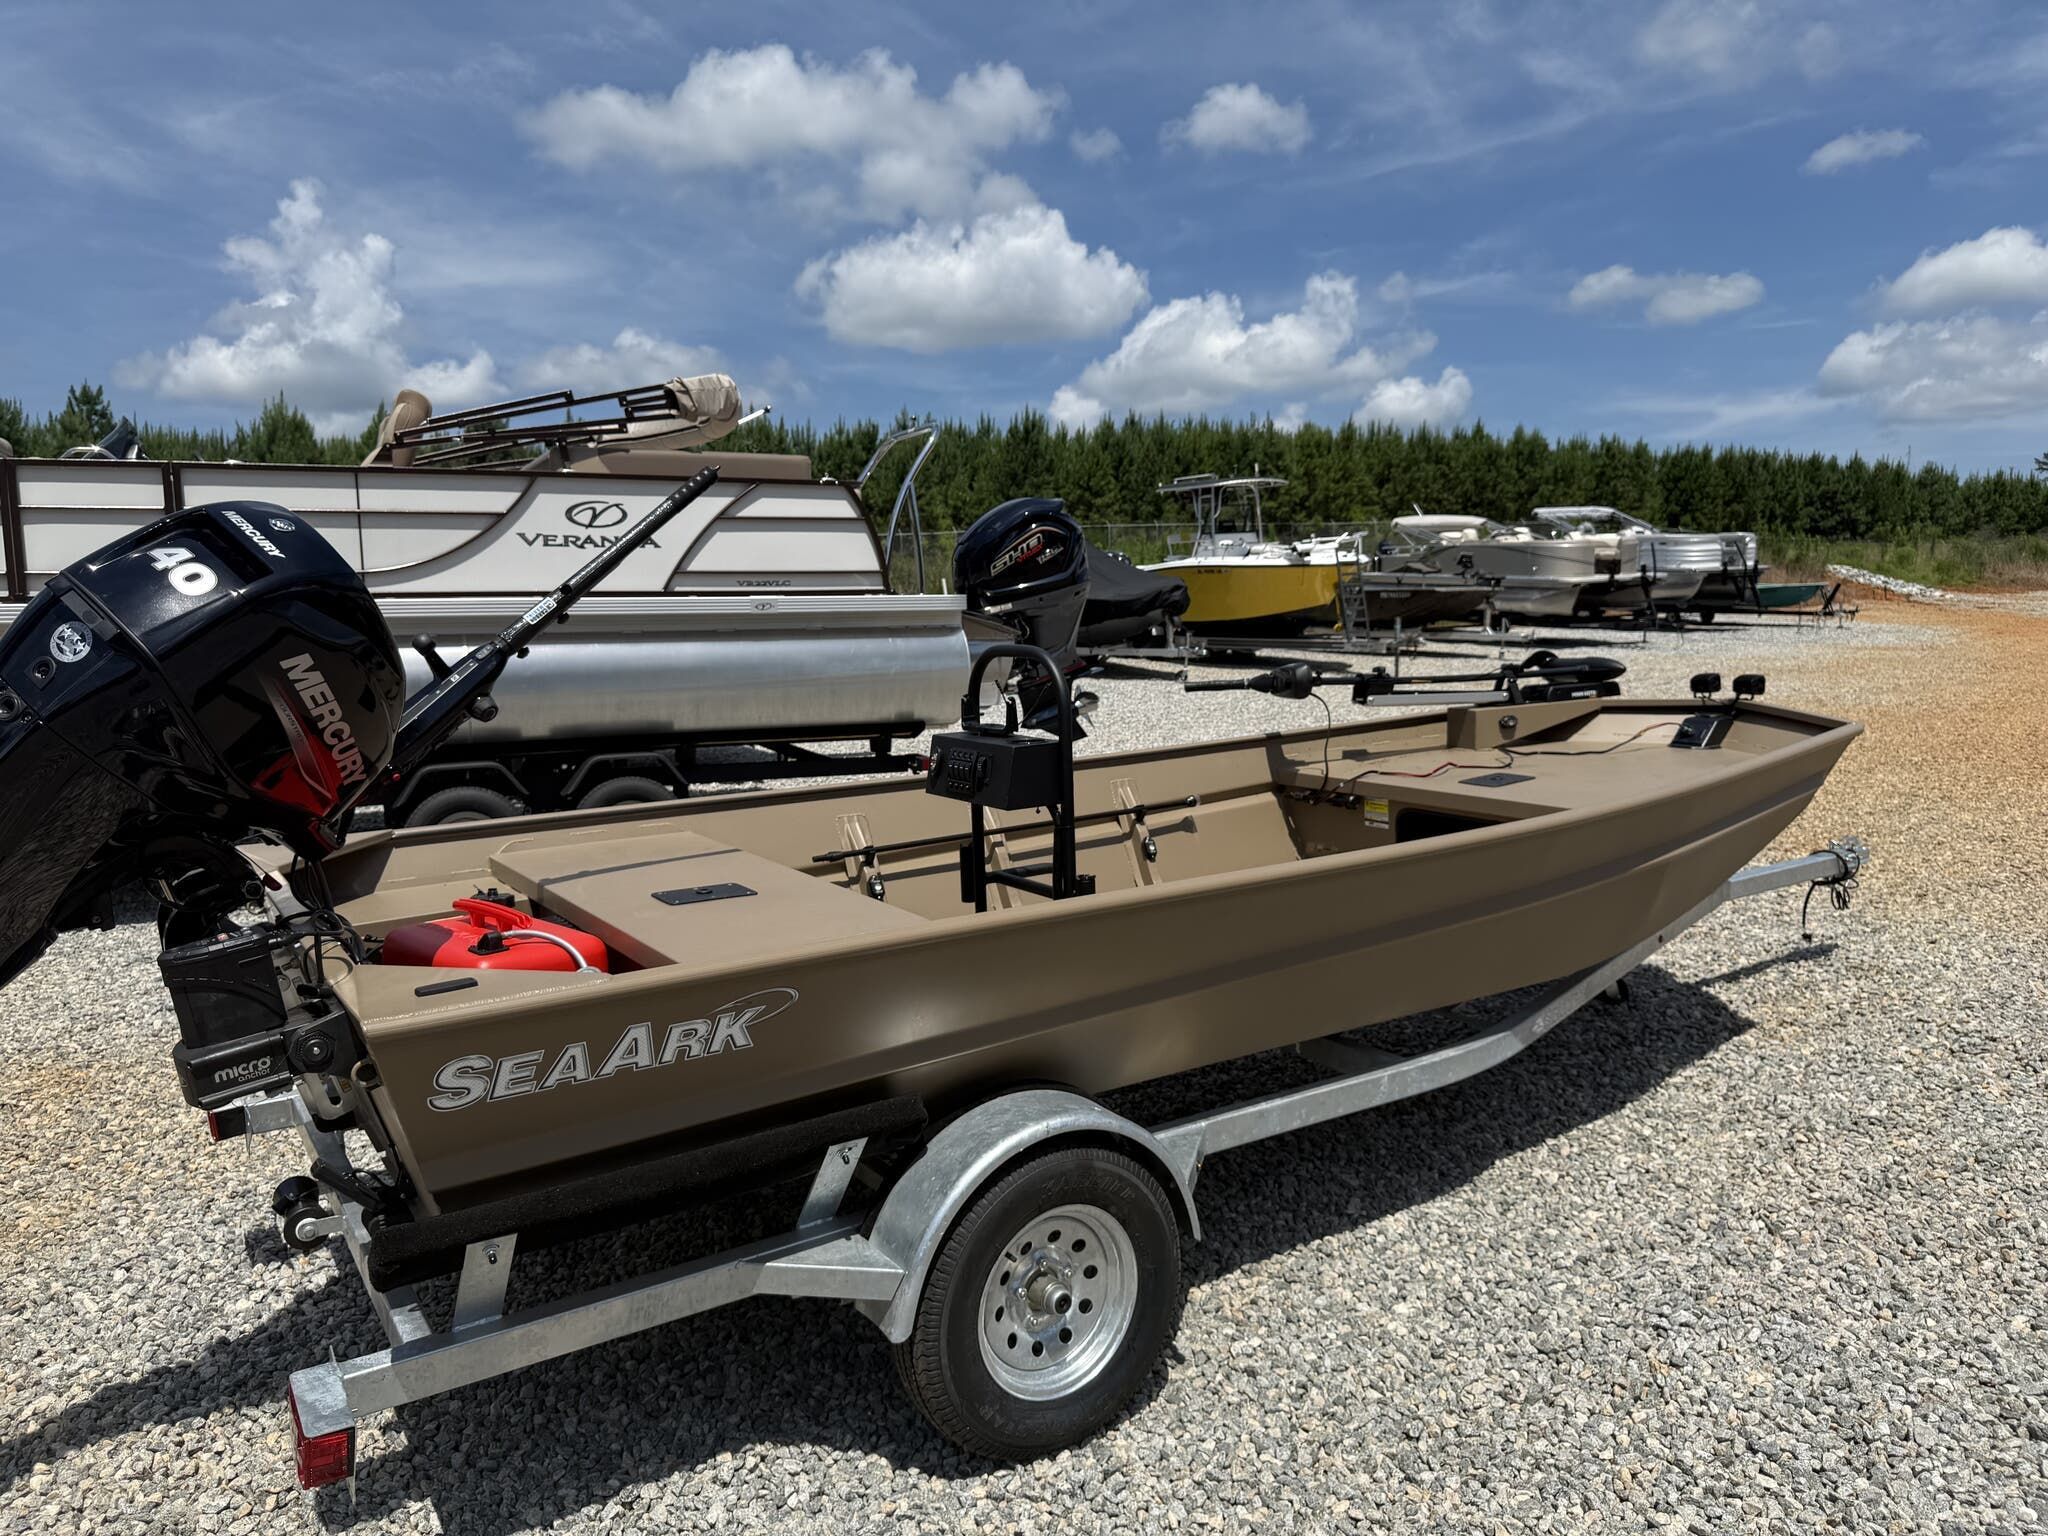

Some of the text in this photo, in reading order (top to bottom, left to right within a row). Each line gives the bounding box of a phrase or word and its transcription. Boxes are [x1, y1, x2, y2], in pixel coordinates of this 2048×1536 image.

[221, 511, 286, 557] MERCURY
[516, 532, 662, 549] VERANA
[147, 547, 219, 596] 40
[279, 652, 367, 786] MERCURY
[214, 1056, 271, 1083] micro
[238, 1068, 271, 1082] anchor
